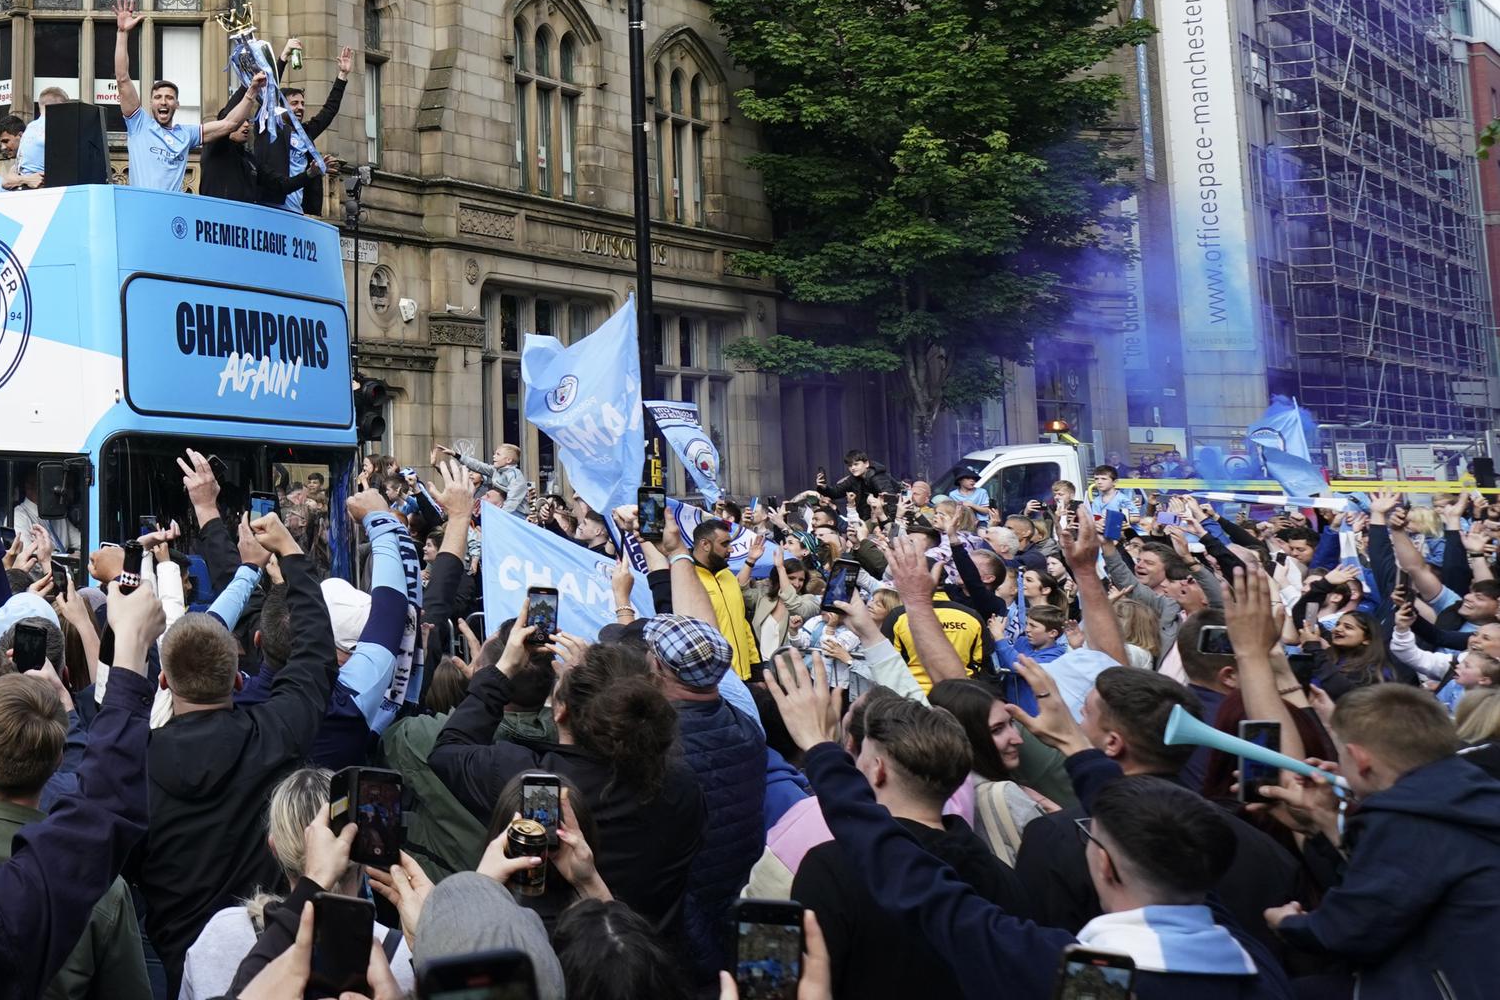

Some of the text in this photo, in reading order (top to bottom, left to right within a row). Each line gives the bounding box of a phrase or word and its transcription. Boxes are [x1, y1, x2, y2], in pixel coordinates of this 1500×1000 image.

[195, 219, 249, 250] PREMIER
[251, 230, 287, 257] LEAGUE
[292, 236, 318, 263] 21/22
[340, 238, 379, 251] OHN ALTON
[346, 250, 368, 260] STEET
[581, 229, 667, 265] KATSOUIS
[10, 311, 22, 321] 94
[176, 301, 329, 370] CHAMPIONS
[216, 350, 302, 400] AGAIN!
